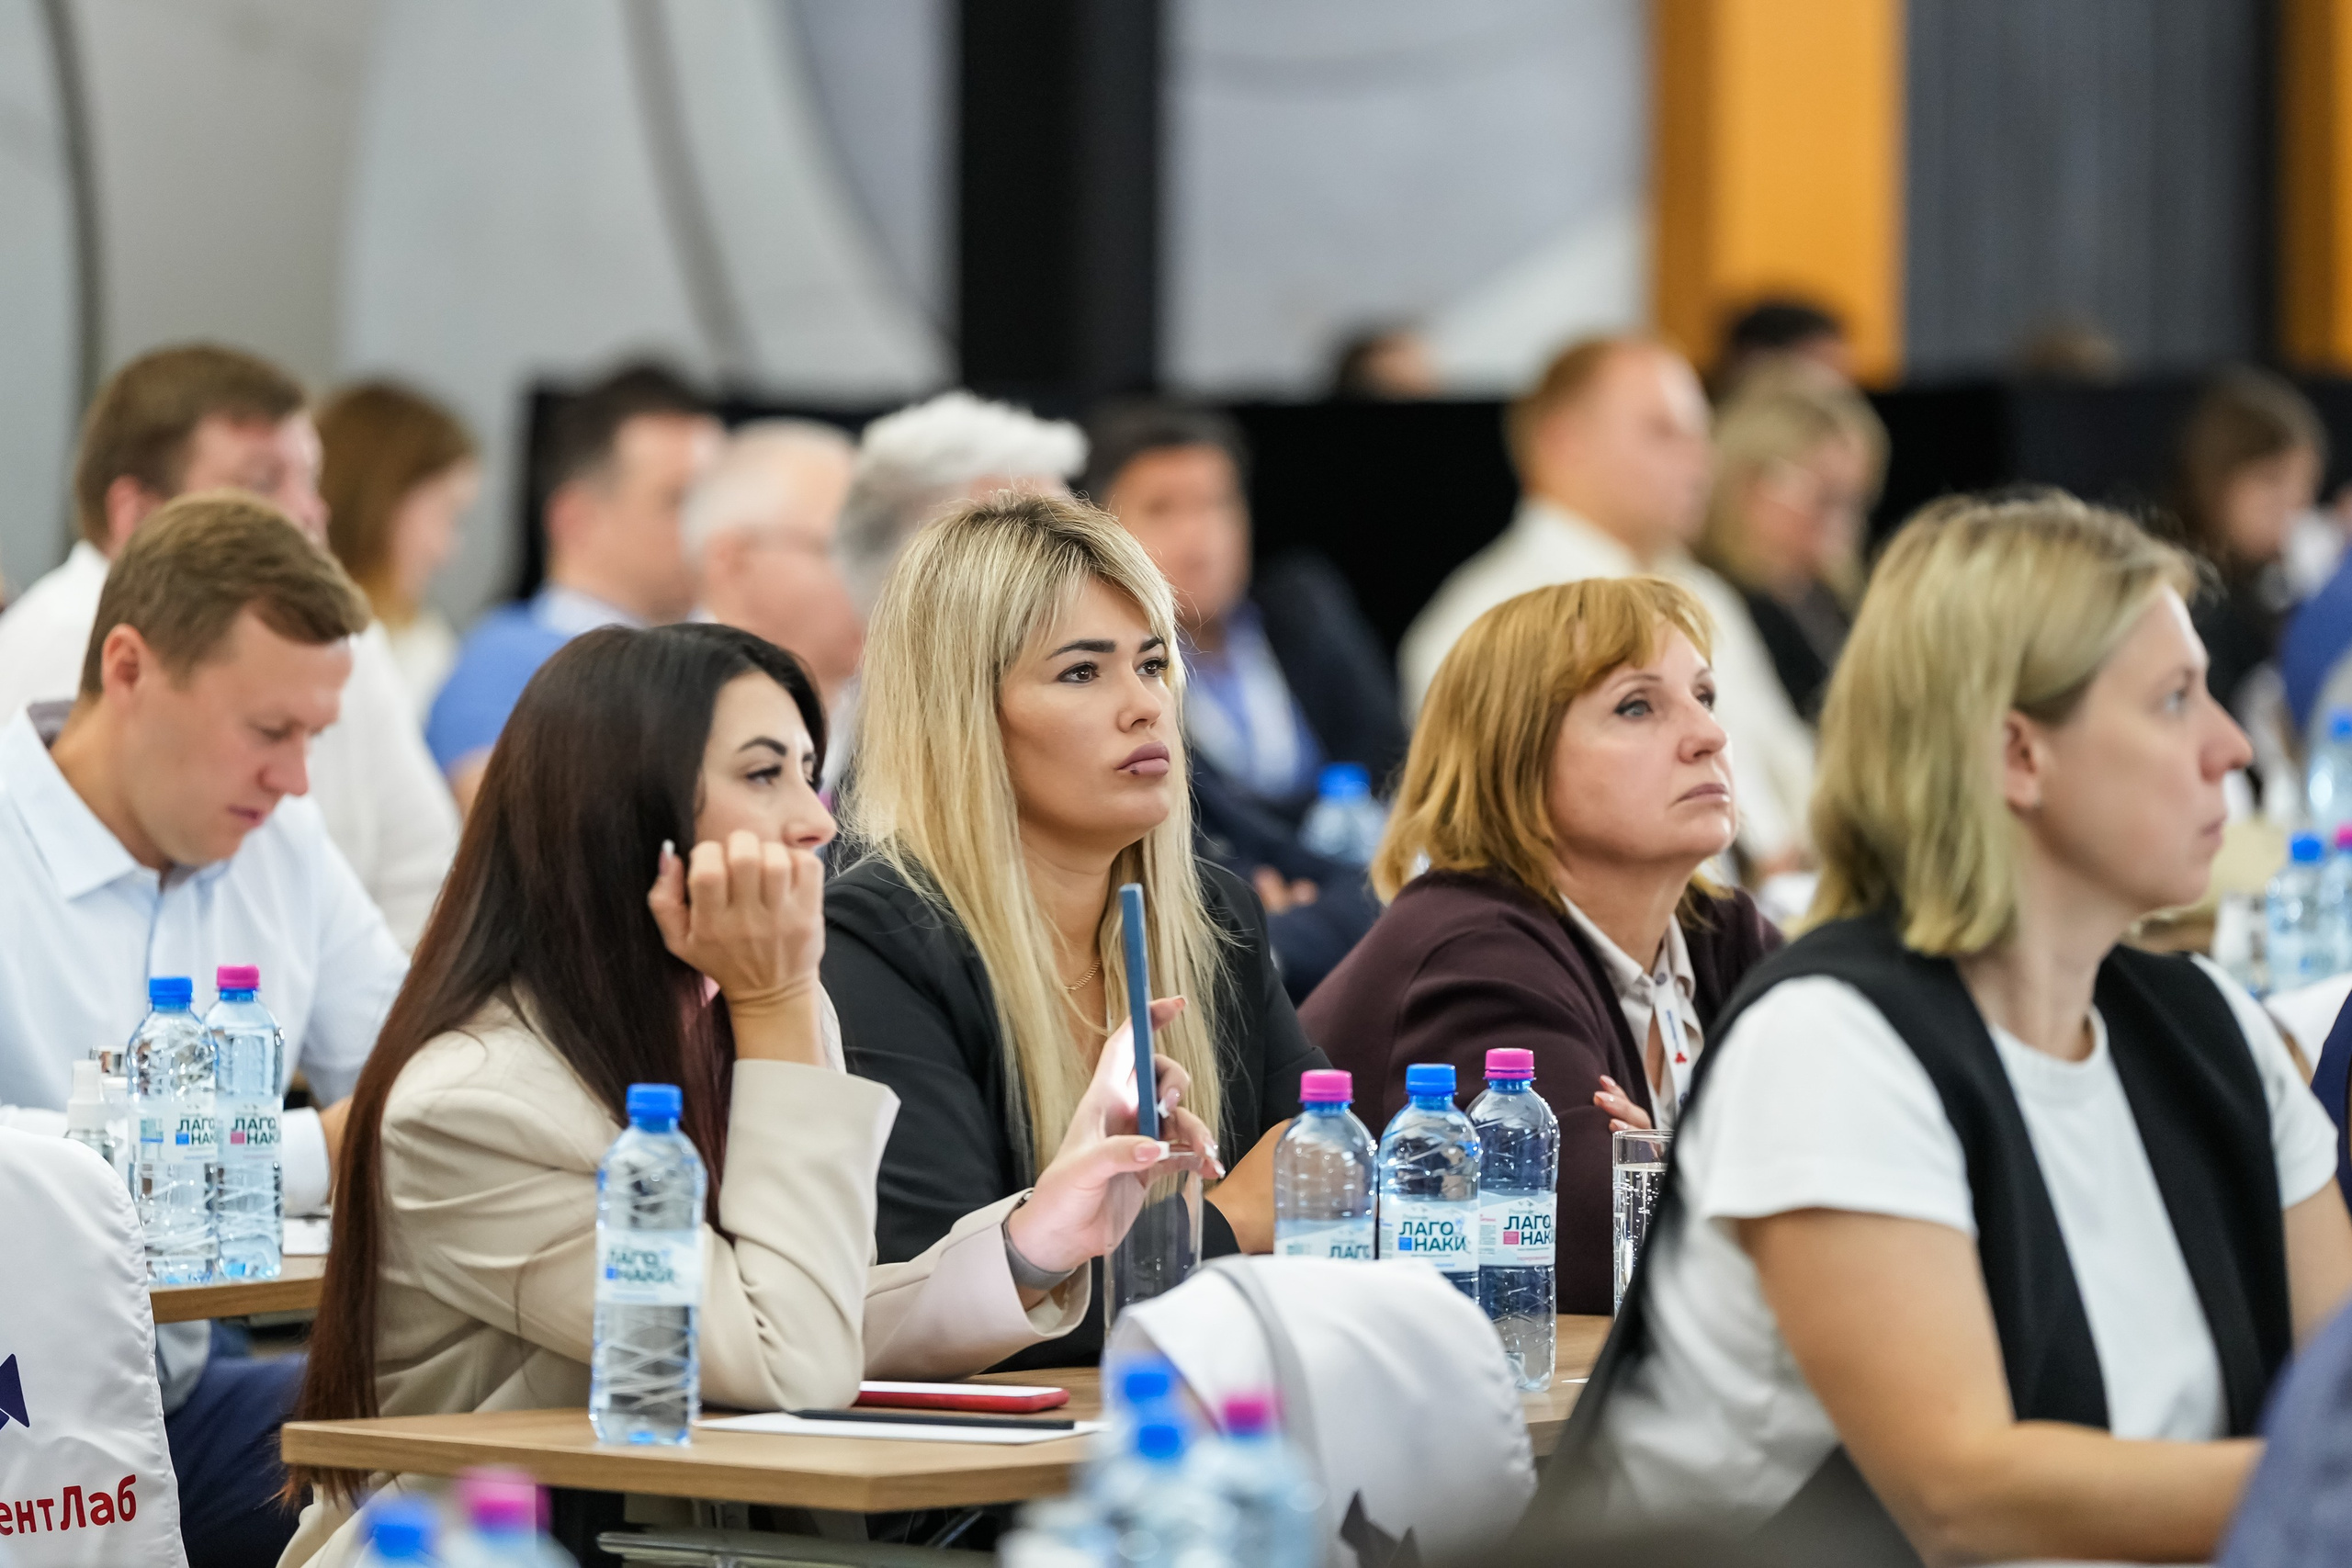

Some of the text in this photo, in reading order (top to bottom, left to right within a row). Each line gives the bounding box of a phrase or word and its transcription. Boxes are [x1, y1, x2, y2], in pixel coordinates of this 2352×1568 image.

[231, 1117, 277, 1132] ЛАГО
[1398, 1221, 1454, 1236] ЛАГО
[1503, 1214, 1551, 1230] ЛАГО
[1414, 1235, 1467, 1252] НАКИ
